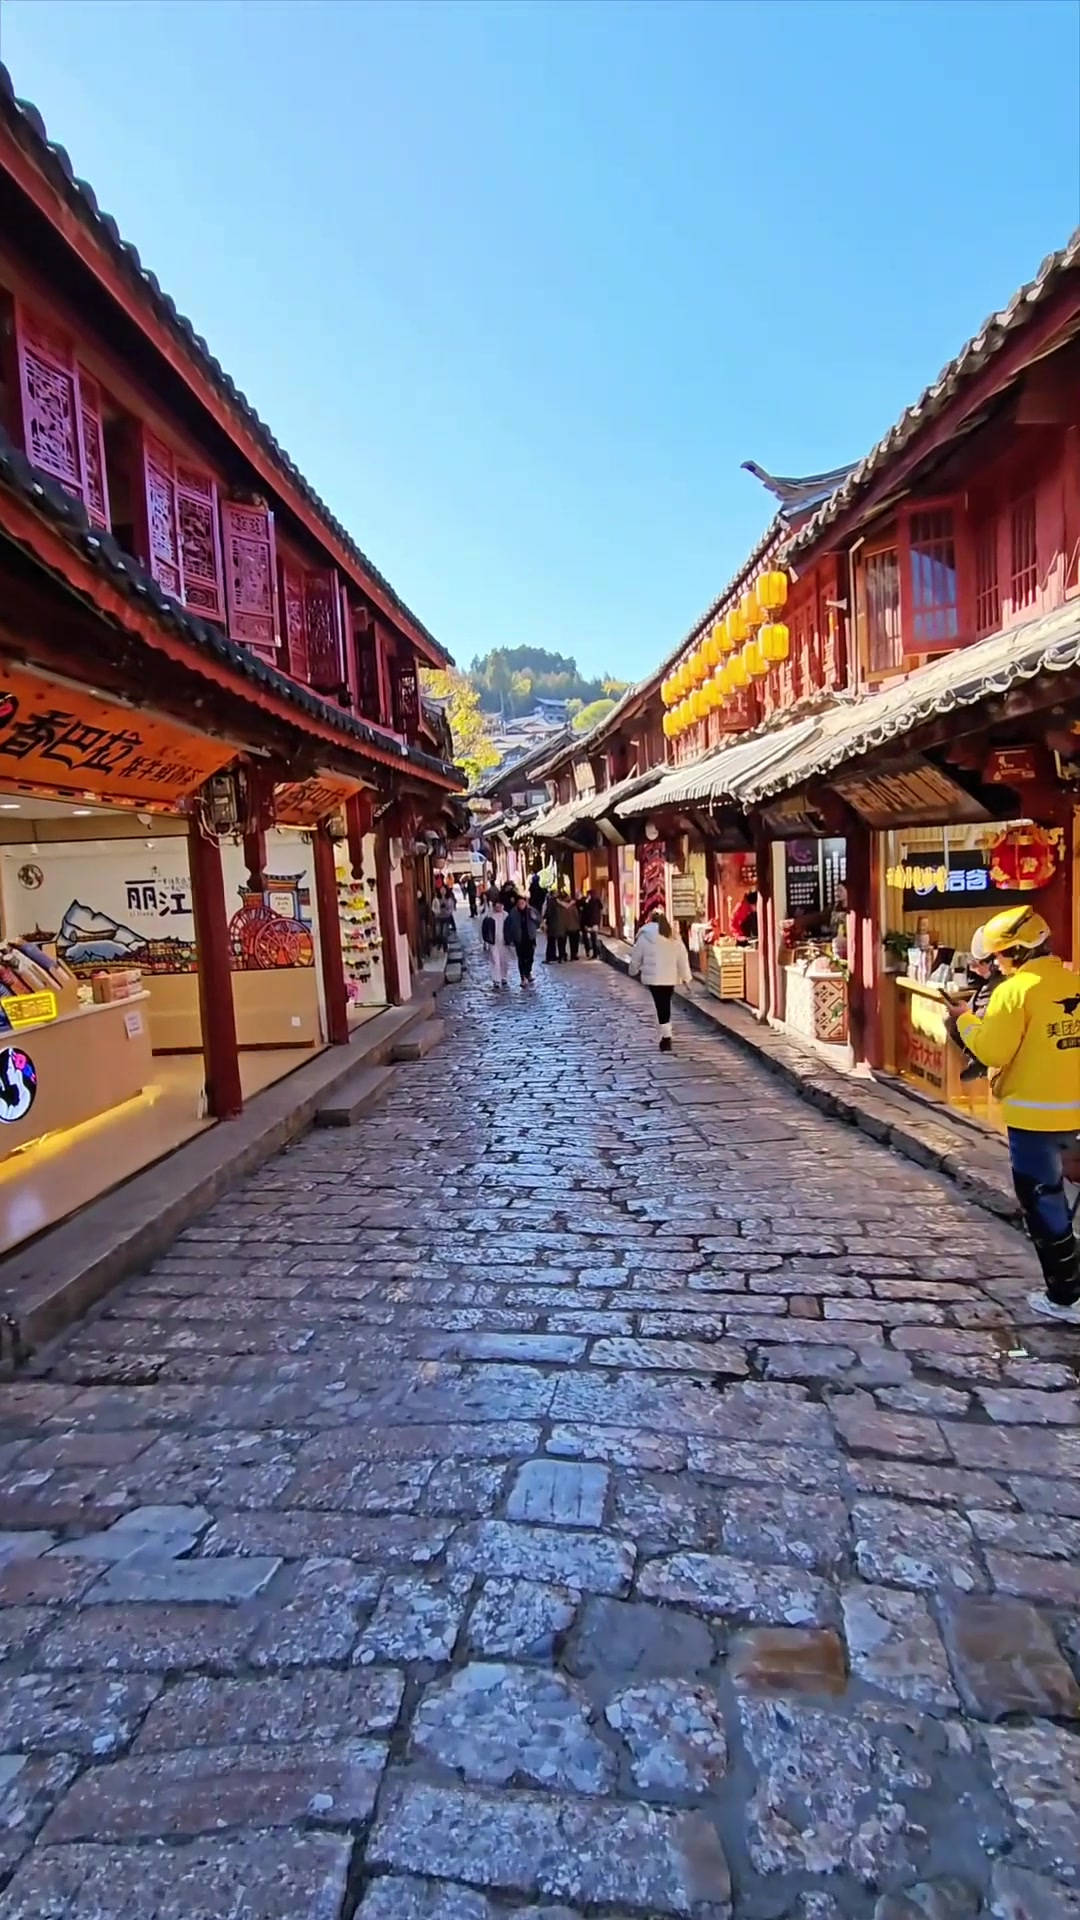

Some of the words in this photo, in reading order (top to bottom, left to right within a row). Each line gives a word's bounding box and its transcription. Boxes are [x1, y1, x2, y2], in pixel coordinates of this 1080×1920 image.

[0, 710, 144, 775] 香巴拉
[125, 880, 192, 917] 丽江
